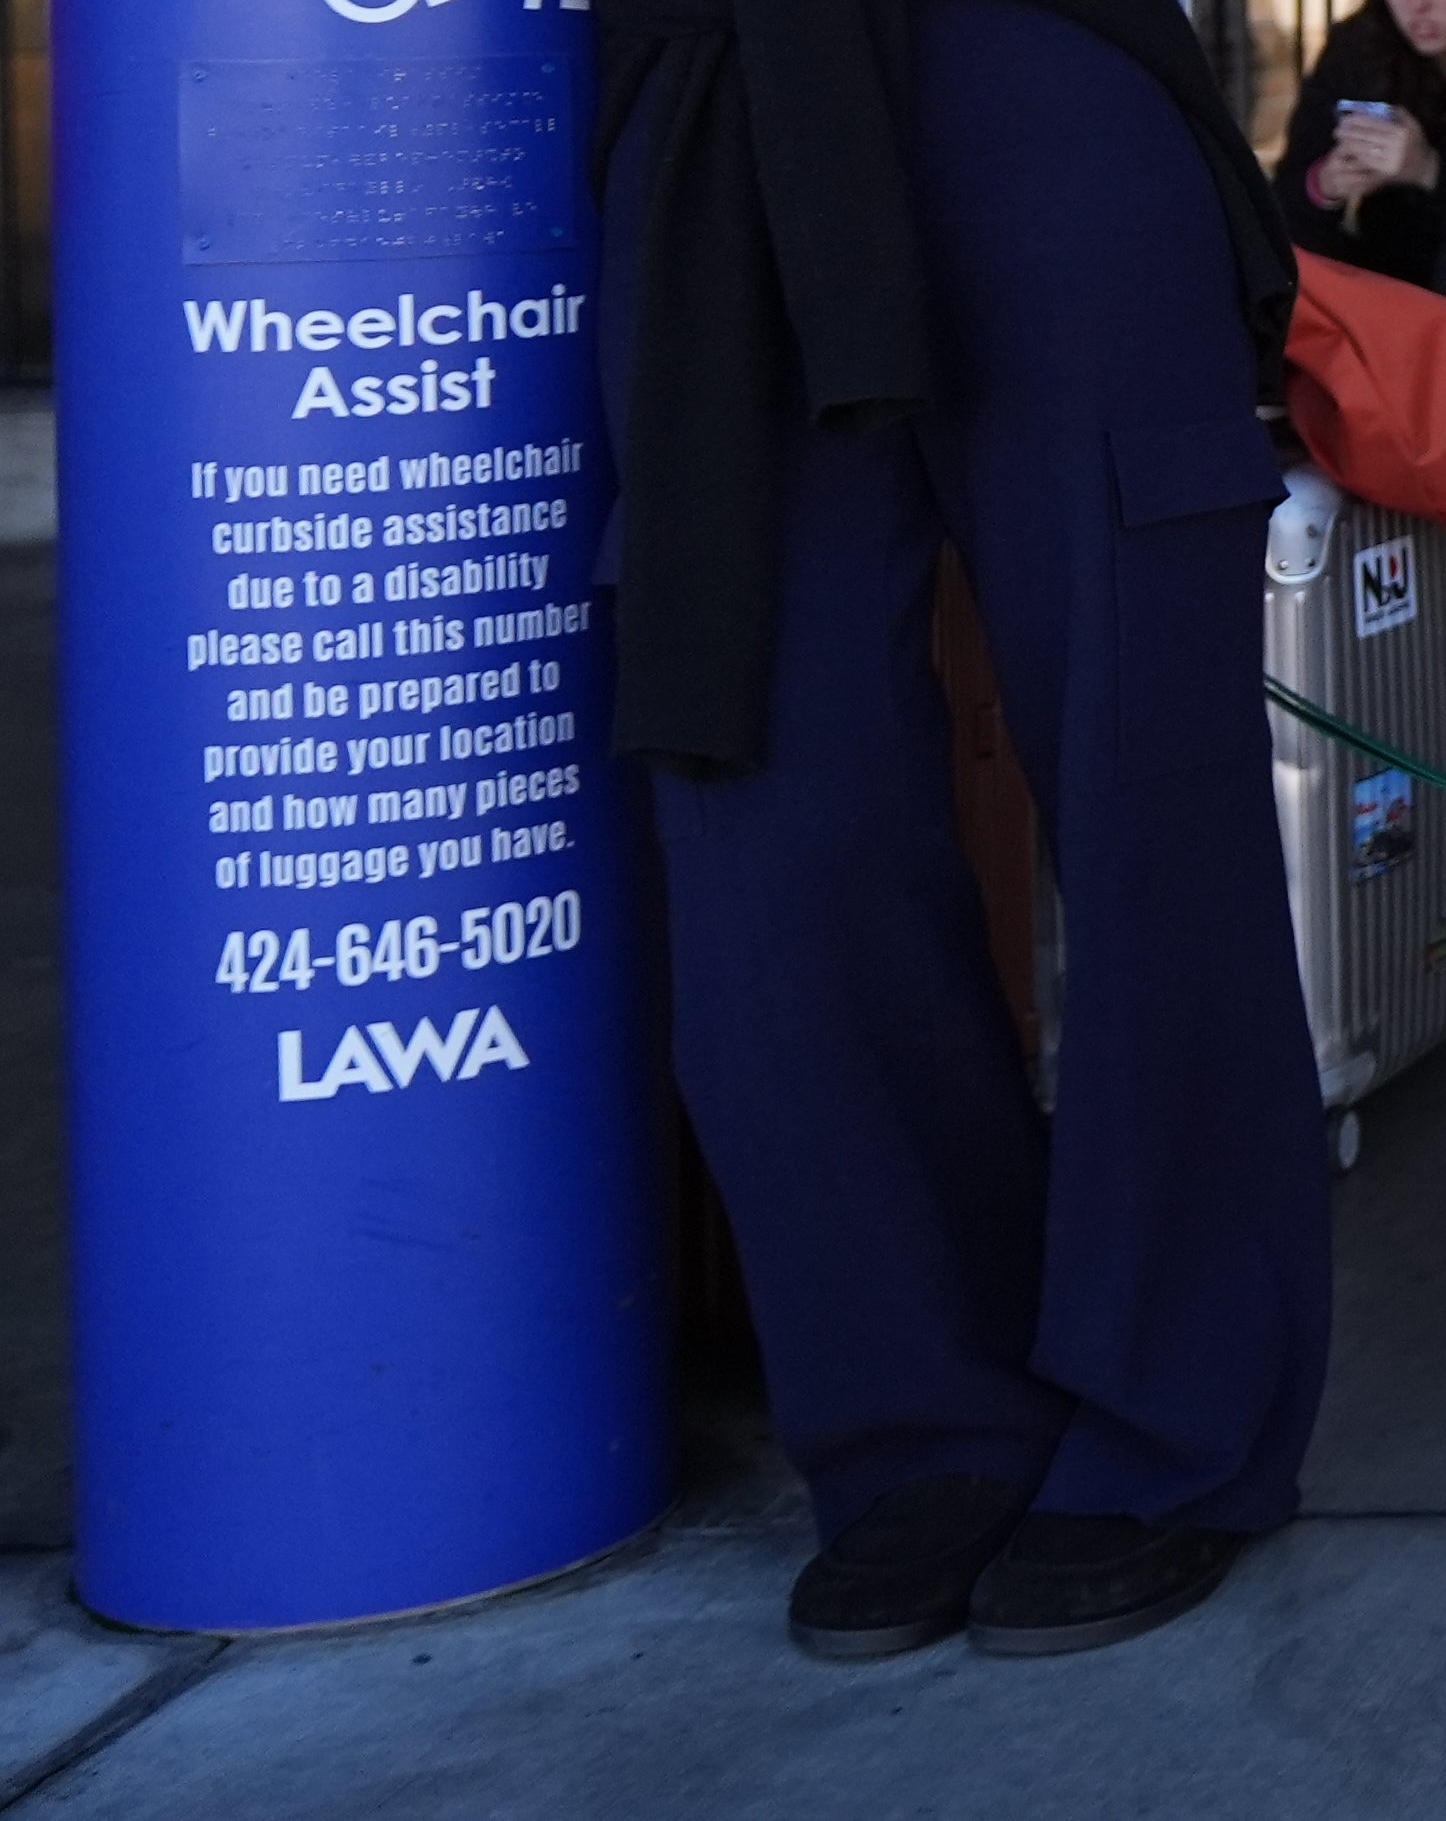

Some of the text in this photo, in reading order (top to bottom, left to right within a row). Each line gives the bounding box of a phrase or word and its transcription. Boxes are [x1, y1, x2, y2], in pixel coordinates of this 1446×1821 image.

[182, 283, 586, 354] Wheelchair
[291, 354, 498, 422] Assist
[191, 437, 585, 506] If you need wheelchair
[211, 497, 569, 557] curbside assistance
[227, 550, 551, 612] due to a disability
[188, 600, 591, 672] please call this number
[226, 658, 560, 723] and be prepared to
[204, 710, 575, 783] provide your location
[208, 763, 581, 834] and how many pieces
[214, 819, 575, 890] of luggage you have.
[215, 889, 582, 994] 424-646-5020
[278, 1004, 530, 1103] LAWA
